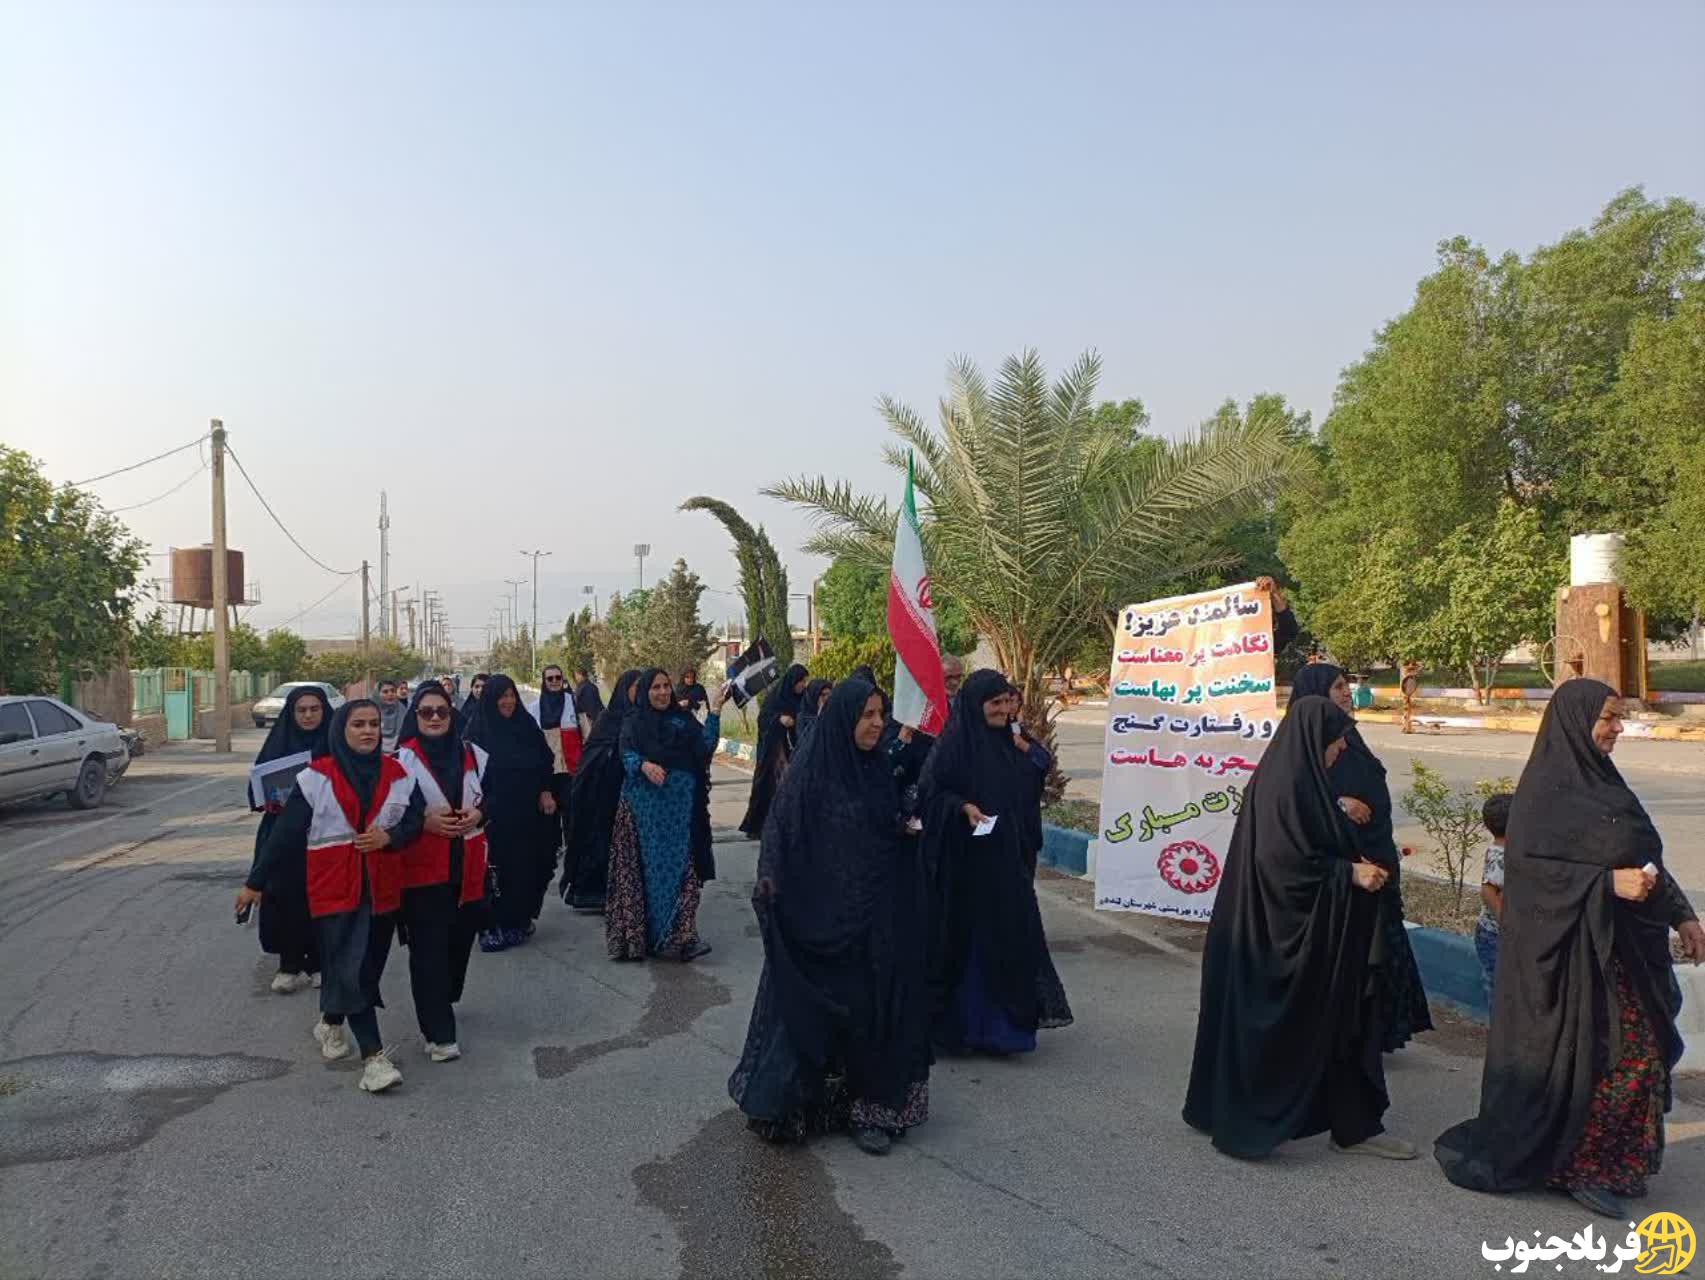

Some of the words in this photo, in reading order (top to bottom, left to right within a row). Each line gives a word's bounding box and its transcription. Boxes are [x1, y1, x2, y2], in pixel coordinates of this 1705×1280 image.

[1117, 646, 1184, 664] معناست
[1211, 633, 1270, 657] نگاهت
[1114, 679, 1177, 703] بهاست
[1182, 683, 1203, 704] پر
[1208, 673, 1272, 697] سخنت
[1260, 719, 1273, 739] و
[1110, 747, 1188, 769] هاست
[1104, 802, 1202, 844] مبارک
